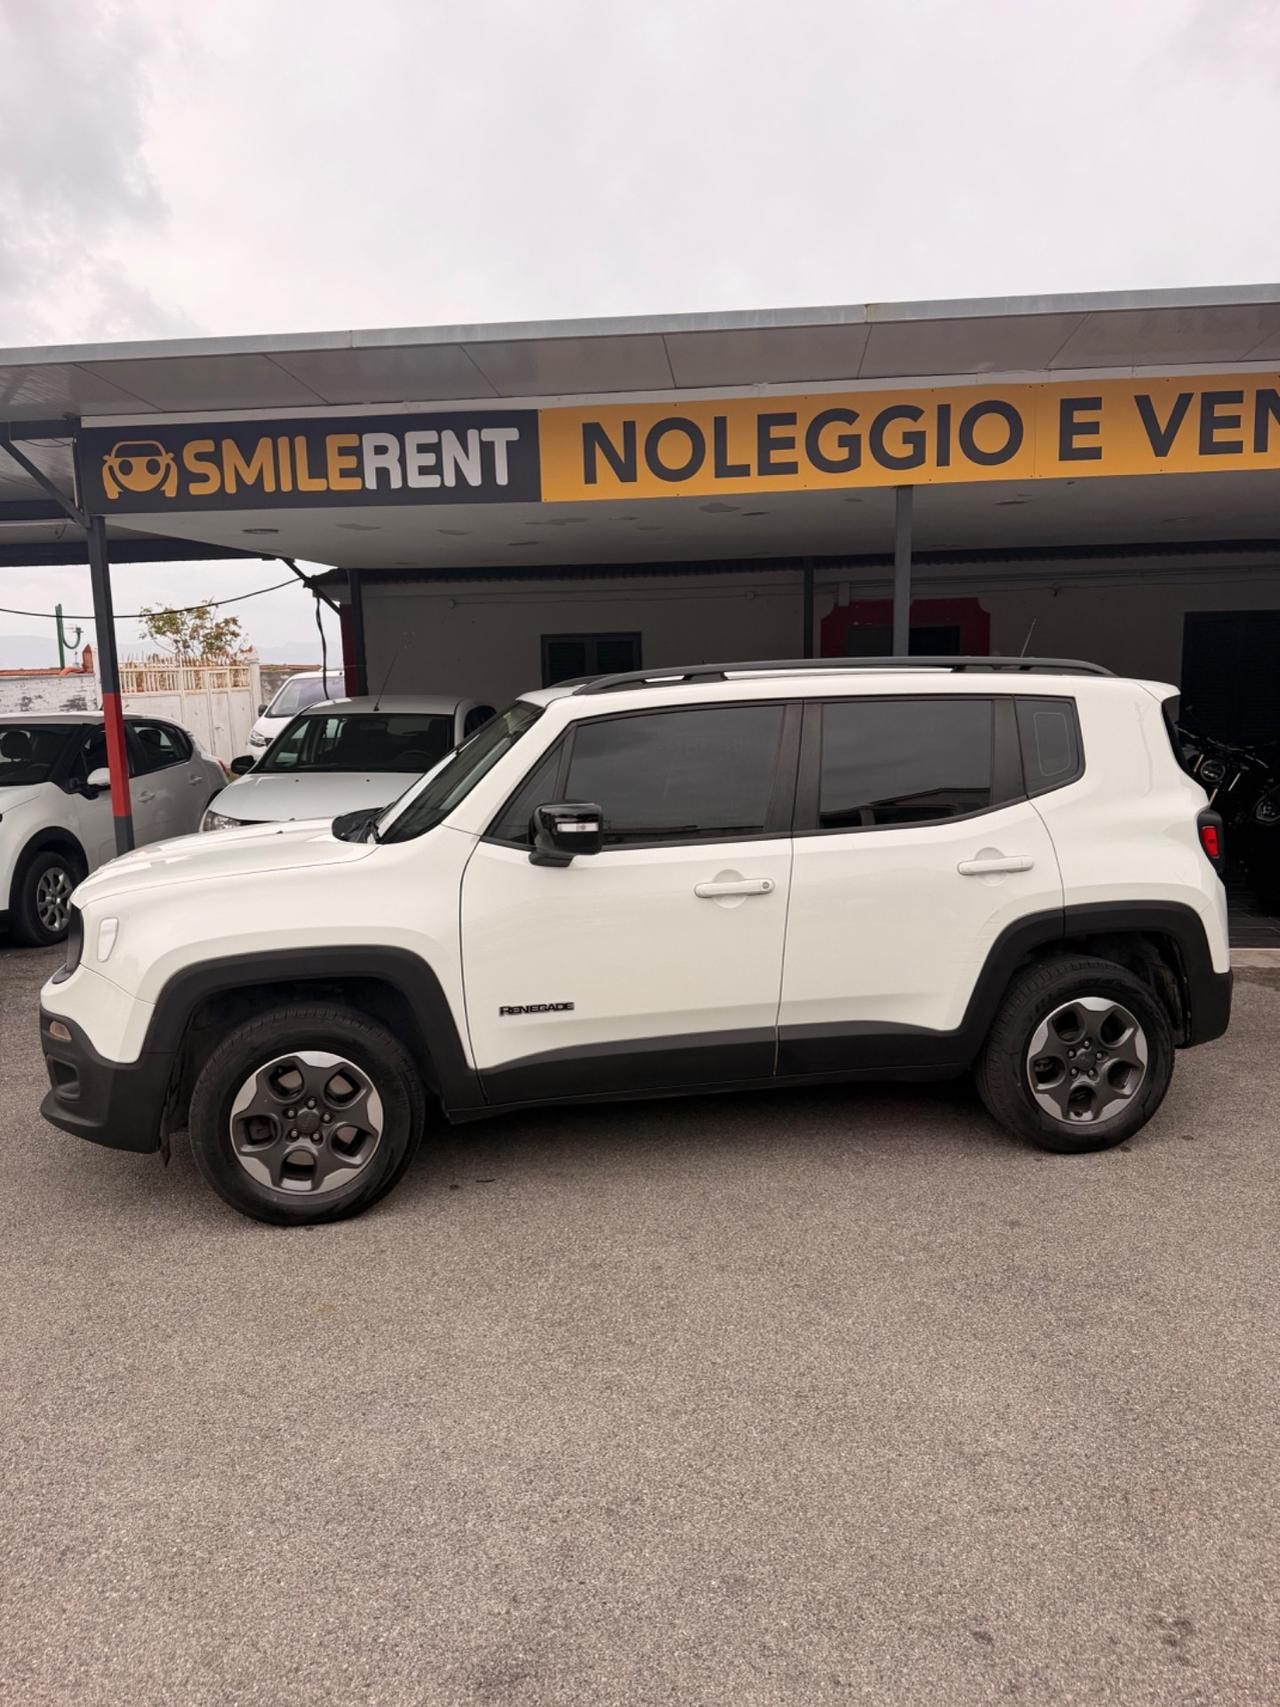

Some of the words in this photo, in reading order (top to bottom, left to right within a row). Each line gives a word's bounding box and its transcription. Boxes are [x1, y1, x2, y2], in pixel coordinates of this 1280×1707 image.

[183, 428, 519, 495] SMILERENT
[581, 399, 1024, 483] NOLEGGIO
[1059, 397, 1102, 461] E
[499, 1002, 575, 1016] RENEGADE
